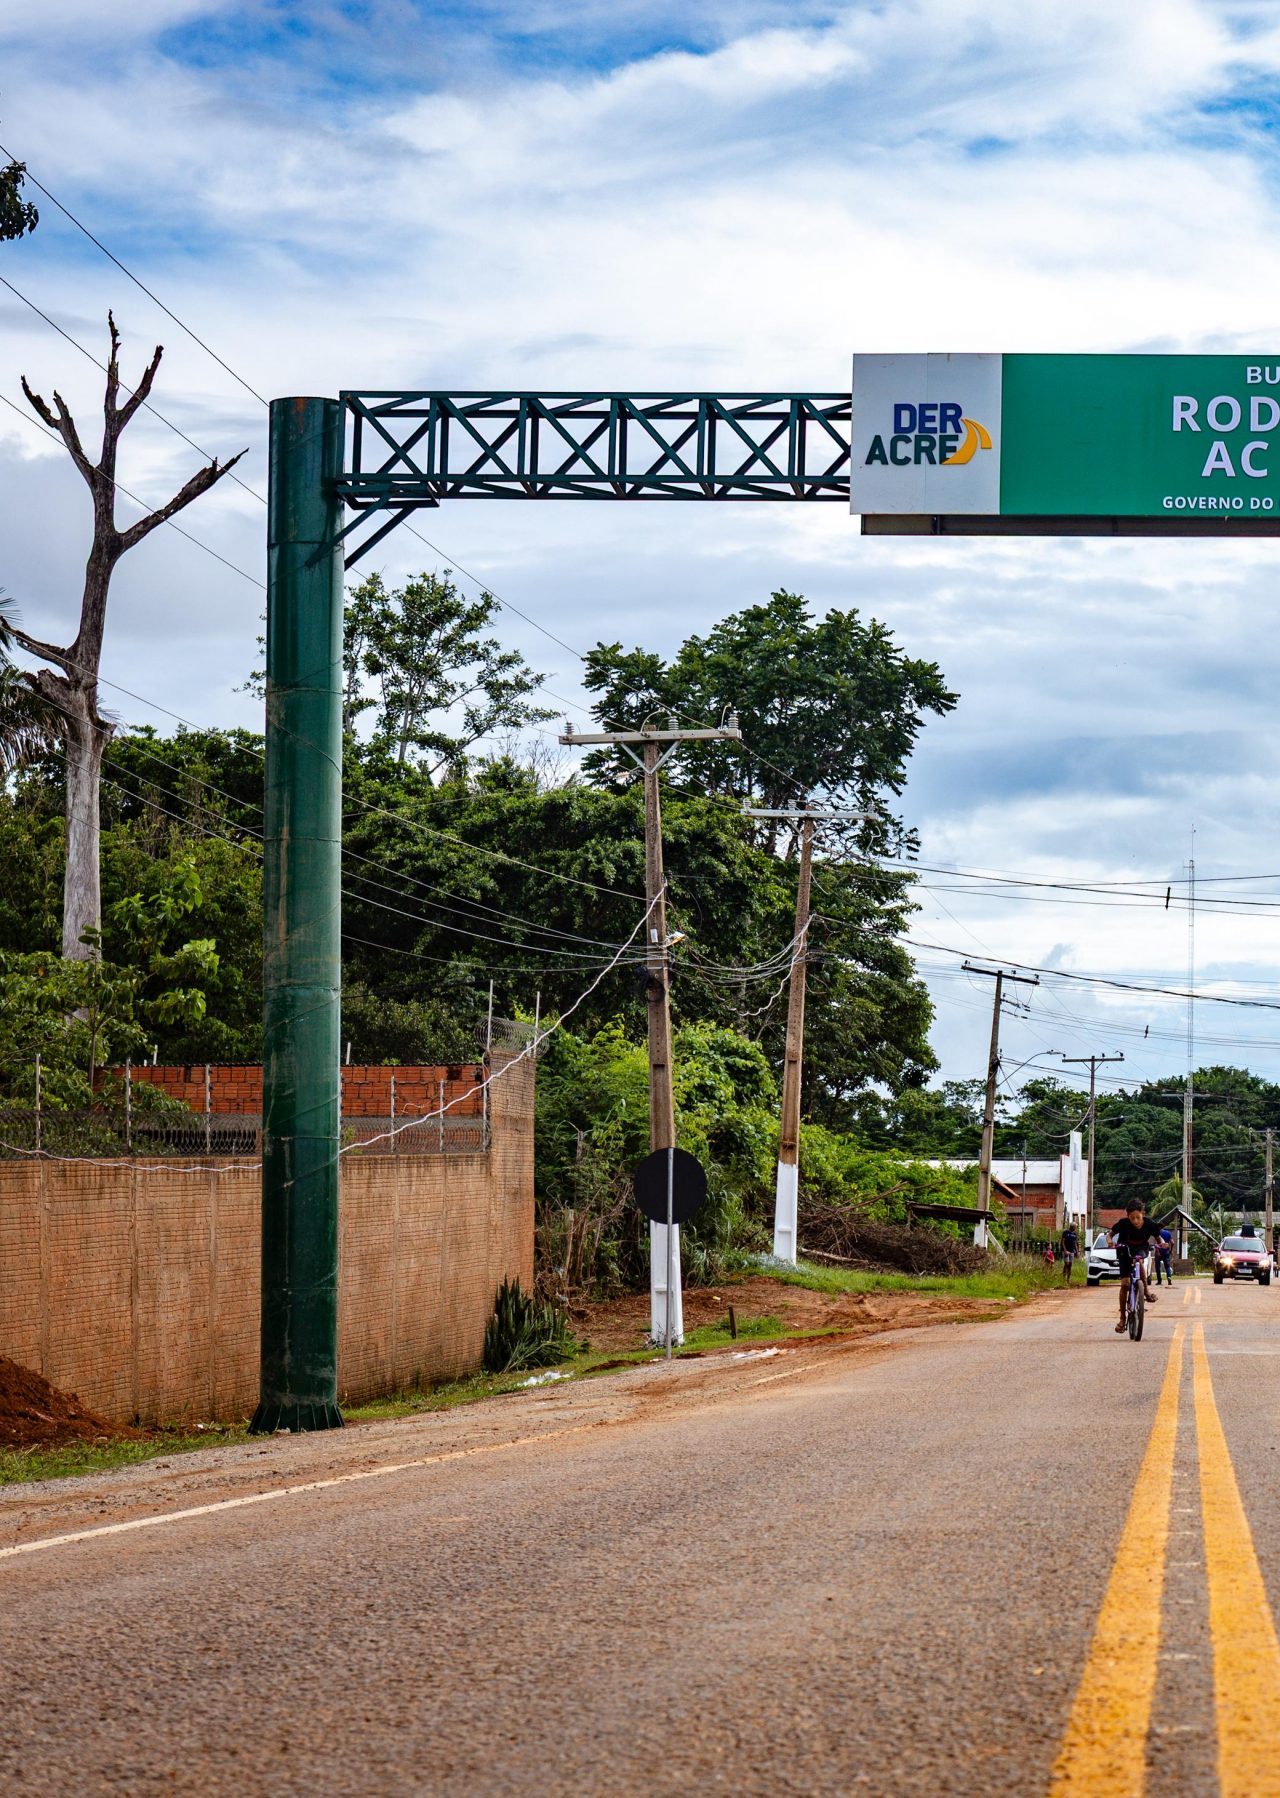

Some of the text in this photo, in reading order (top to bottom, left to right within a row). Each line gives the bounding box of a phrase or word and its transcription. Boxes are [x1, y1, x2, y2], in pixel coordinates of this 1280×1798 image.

[893, 402, 963, 434] DER
[864, 434, 960, 466] ACRE
[1201, 440, 1269, 478] AC
[1162, 495, 1244, 510] GOVERNO
[1250, 497, 1274, 510] DO
